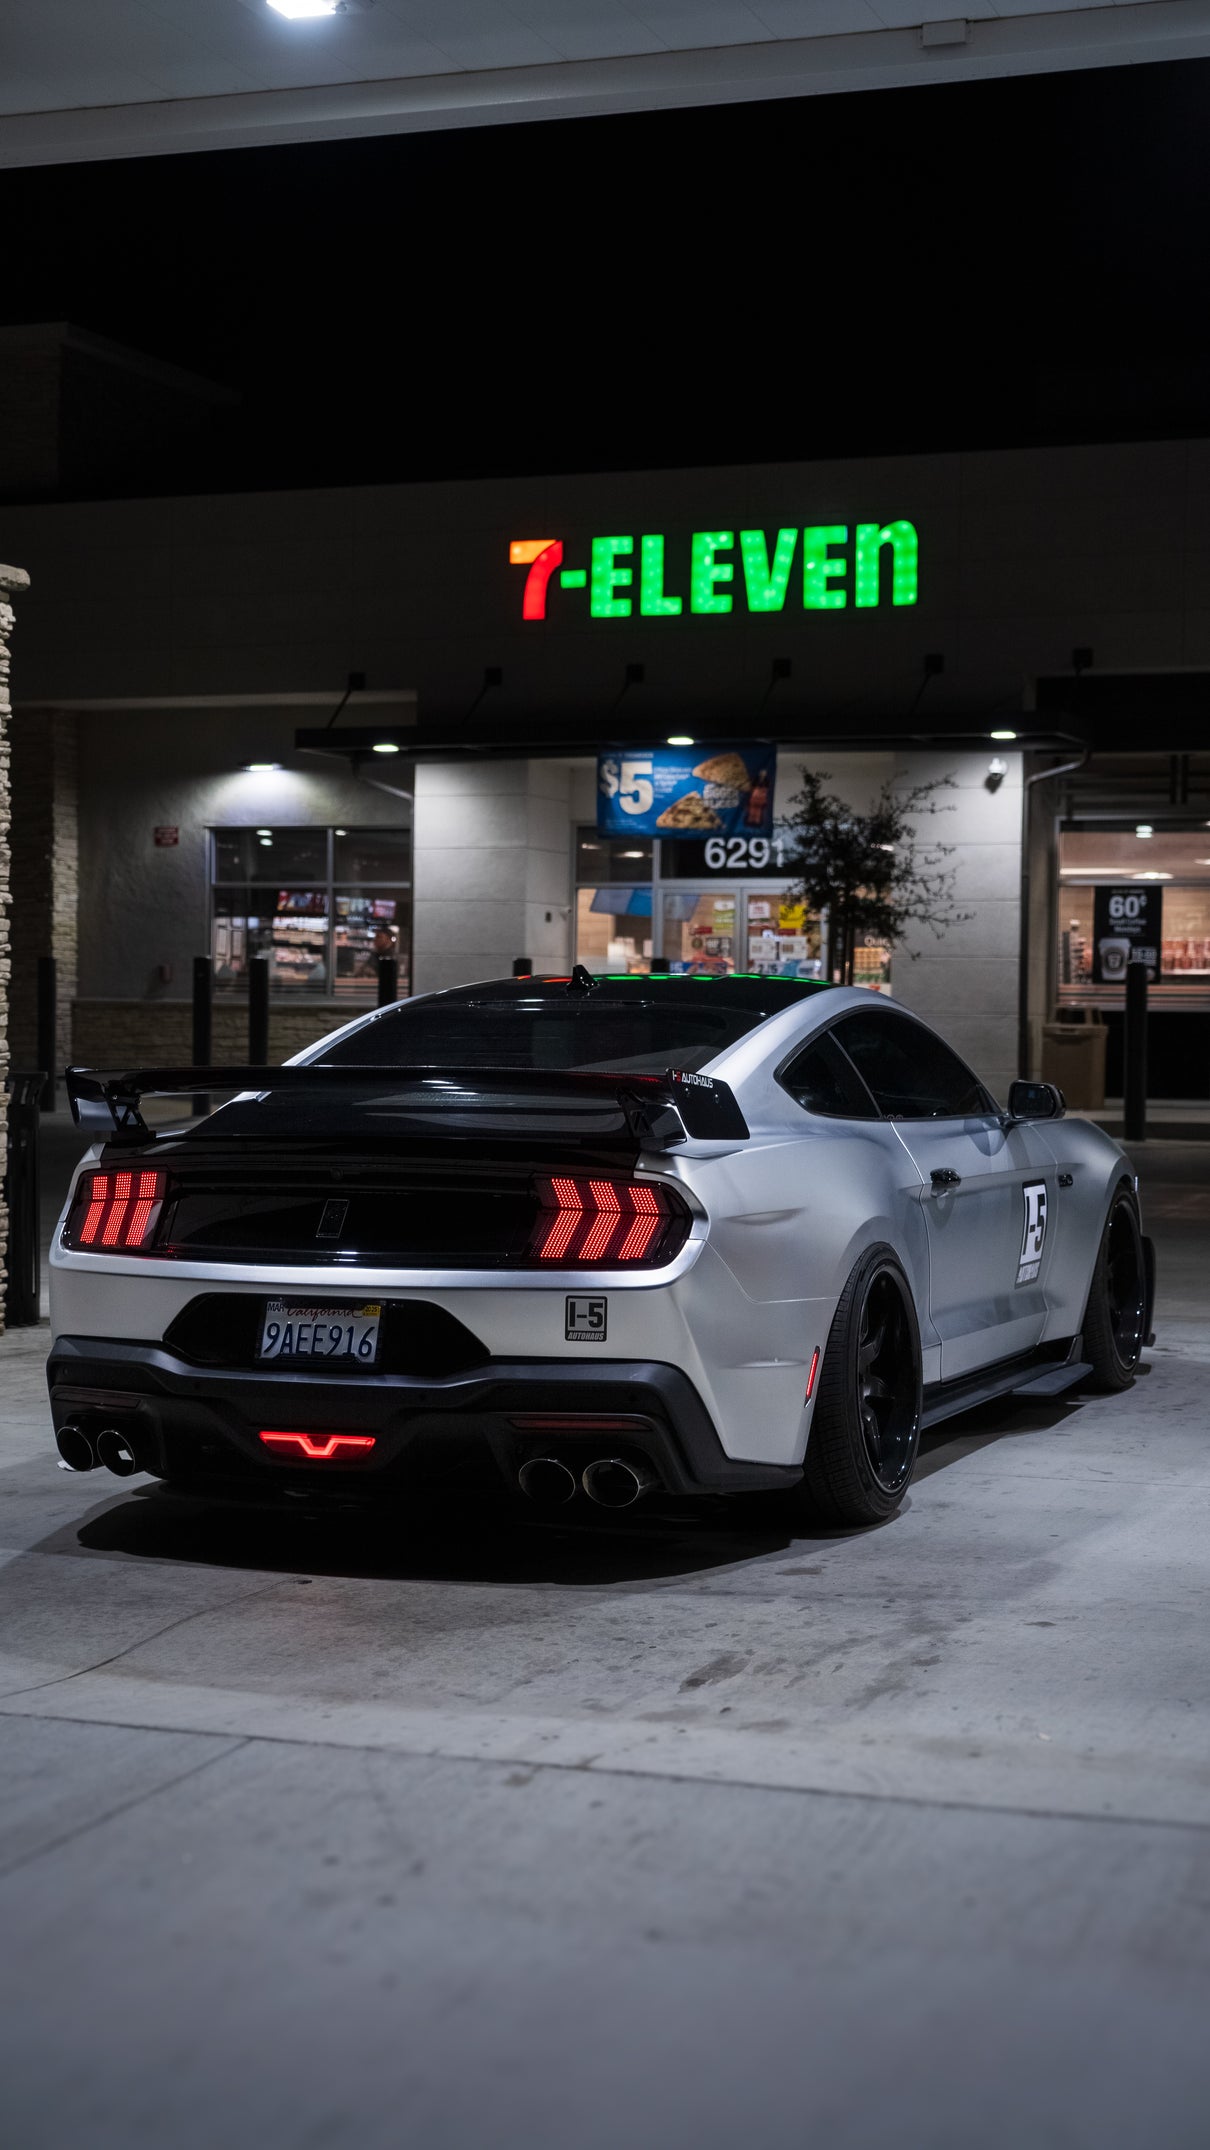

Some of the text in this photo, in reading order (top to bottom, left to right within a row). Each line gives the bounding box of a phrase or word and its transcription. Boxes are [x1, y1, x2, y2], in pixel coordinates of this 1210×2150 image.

[600, 759, 653, 815] $5
[704, 837, 784, 869] 6291
[681, 1072, 713, 1088] AUTOHAUS
[1022, 1193, 1045, 1255] I-5
[267, 1303, 285, 1313] MAR
[569, 1301, 604, 1328] I-5
[264, 1322, 376, 1357] 9AEE916
[567, 1332, 605, 1341] AUTOHAUS
